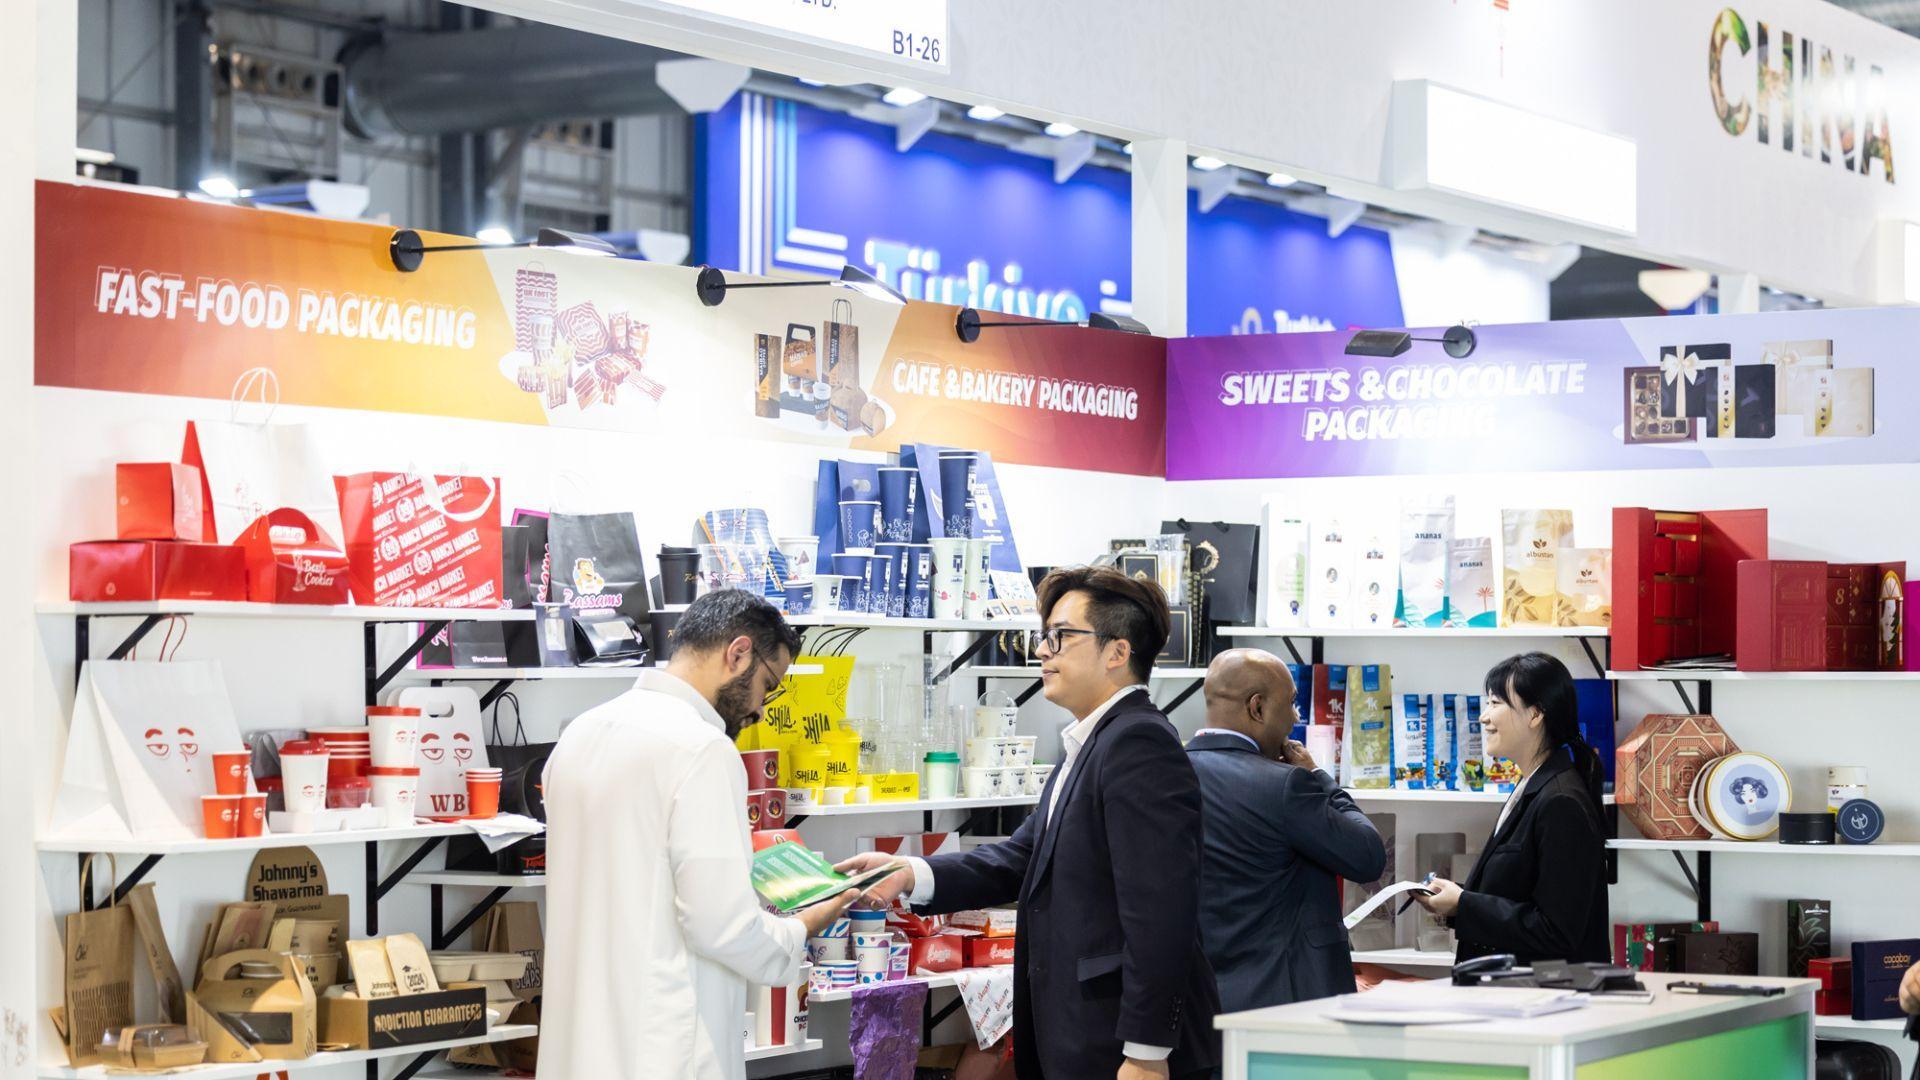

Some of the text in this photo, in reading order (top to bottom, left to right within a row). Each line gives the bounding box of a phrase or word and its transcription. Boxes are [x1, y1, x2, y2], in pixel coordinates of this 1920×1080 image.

[892, 29, 940, 63] B1-26
[1708, 8, 1895, 184] CHINA
[97, 269, 477, 350] FAST-FOOD PACKAGING
[892, 362, 940, 396] CAFE
[1038, 379, 1139, 421] PACKAGING
[1220, 371, 1351, 406] SWEETS
[1303, 405, 1496, 442] PACKAGING
[1415, 532, 1442, 540] ananas
[304, 572, 335, 587] Cookies
[563, 588, 623, 609] Rassams
[1835, 588, 1845, 605] 8
[258, 861, 318, 883] Johnny's
[253, 884, 323, 902] Shawarma
[374, 1003, 483, 1033] ADDICTION GUARANTEED
